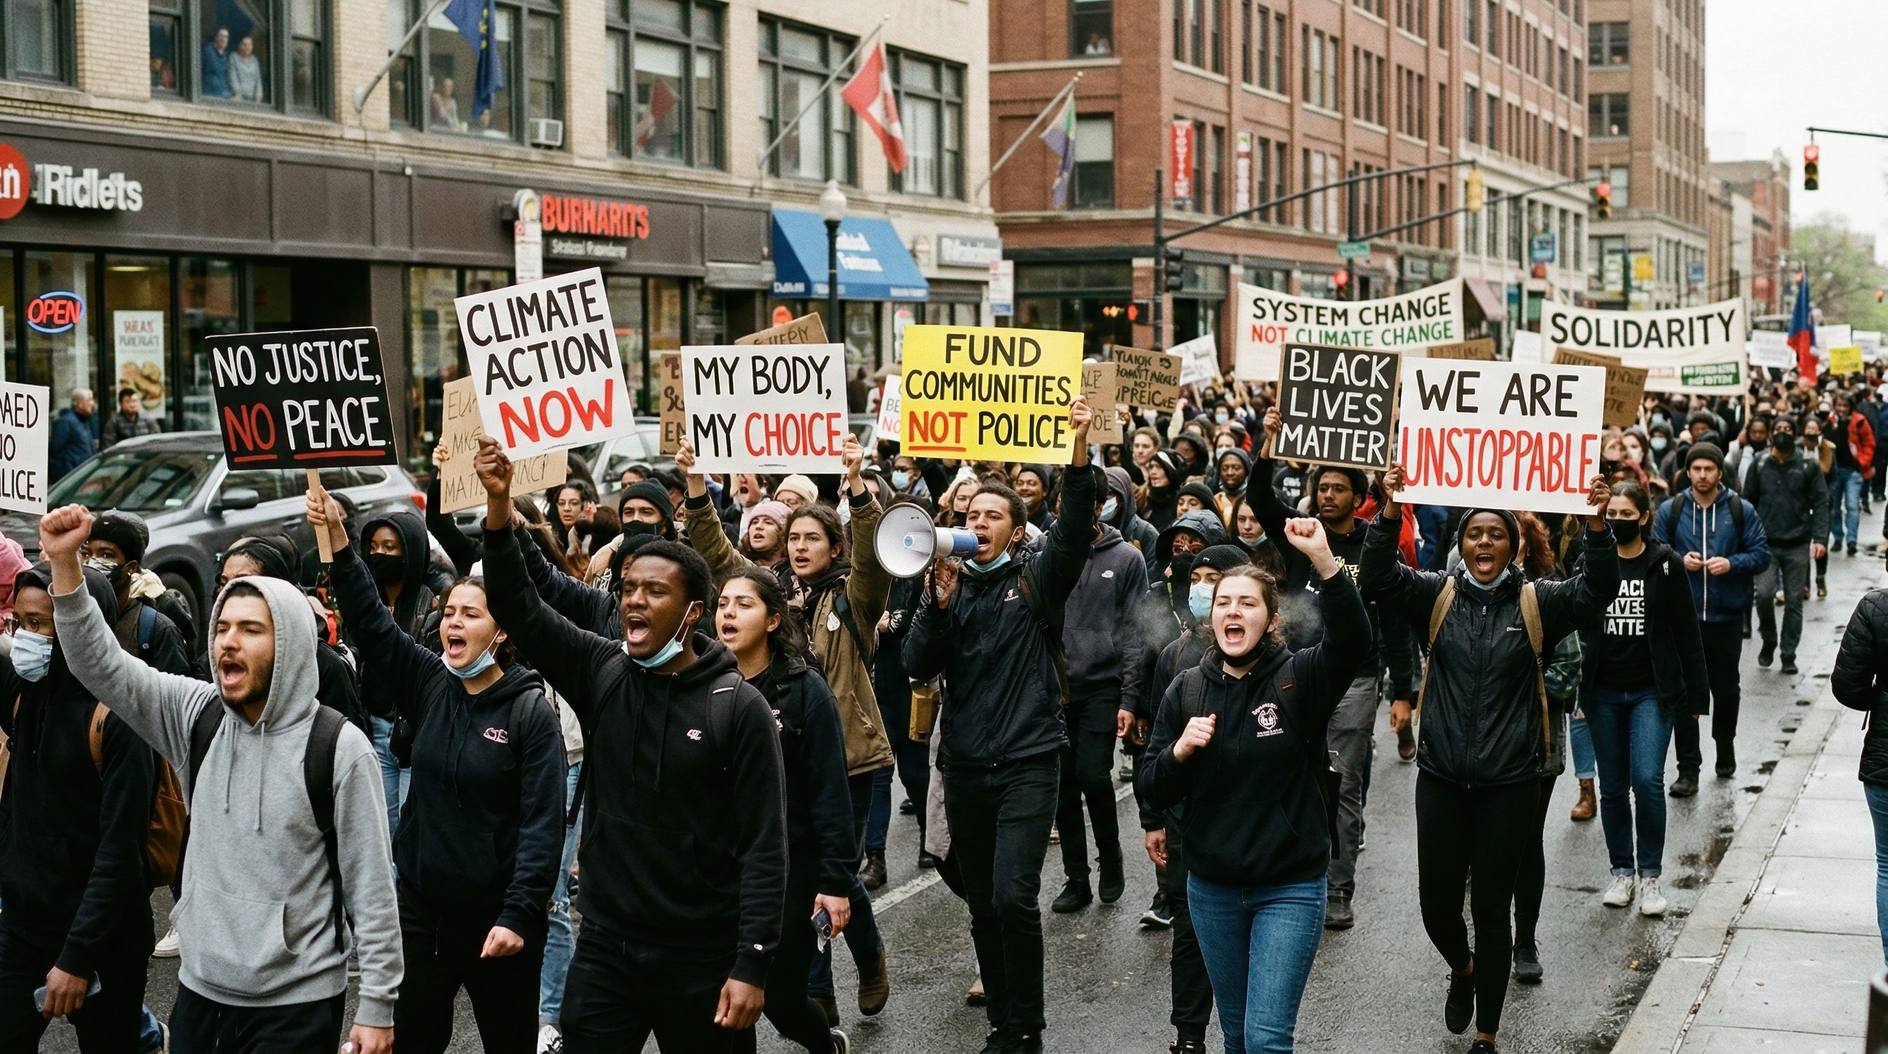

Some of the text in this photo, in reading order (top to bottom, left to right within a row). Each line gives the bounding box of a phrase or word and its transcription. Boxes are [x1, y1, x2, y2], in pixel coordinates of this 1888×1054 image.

[27, 299, 80, 325] OPEN
[467, 279, 604, 346] CLIMATE
[1253, 292, 1451, 326] SYSTEM CHANGE
[1550, 308, 1735, 349] SOLIDARITY
[945, 333, 1042, 368] FUND
[1251, 320, 1454, 346] NOT CLIMATE CHANGE
[212, 338, 382, 388] NO JUSTICE,
[485, 329, 613, 396] ACTION
[693, 355, 740, 396] MY
[751, 355, 832, 400] BODY,
[1289, 348, 1391, 389] BLACK
[905, 369, 1071, 406] COMMUNITIES
[1290, 386, 1383, 426] LIVES
[1416, 369, 1481, 413] WE
[1499, 373, 1579, 418] ARE
[224, 396, 392, 452] NO PEACE.
[498, 379, 614, 449] NOW
[692, 411, 843, 458] MY CHOICE
[908, 410, 1070, 449] NOT POLICE
[1278, 422, 1385, 465] MATTER
[1401, 426, 1598, 494] UNSTOPPABLE
